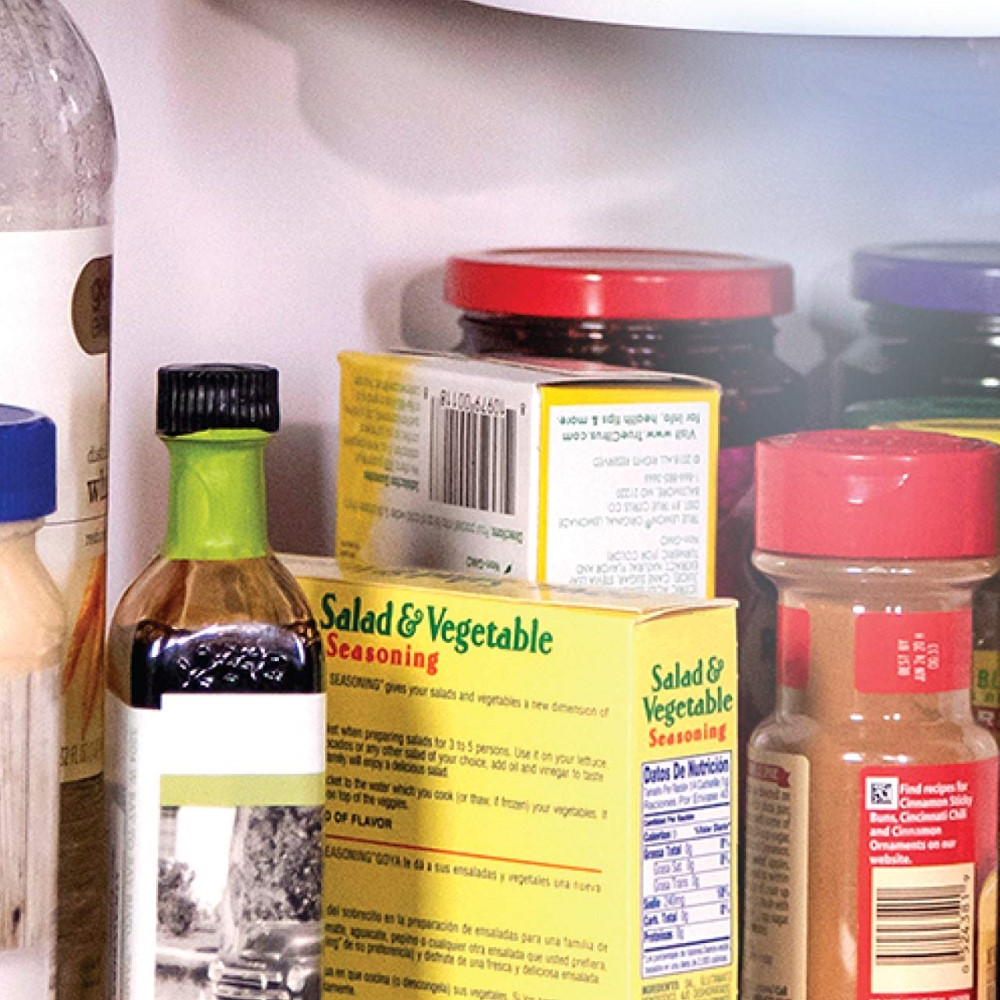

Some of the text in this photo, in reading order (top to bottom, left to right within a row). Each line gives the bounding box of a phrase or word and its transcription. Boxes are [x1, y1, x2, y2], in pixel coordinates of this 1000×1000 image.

[602, 412, 620, 426] tips
[623, 415, 657, 427] health
[675, 429, 696, 440] Visit
[320, 592, 554, 655] Salad & Vegetable
[326, 632, 439, 676] Seasoning
[652, 655, 725, 692] Salad &
[642, 685, 733, 728] Vegetable
[649, 722, 727, 748] Seasoning
[643, 765, 671, 784] Datos
[901, 780, 968, 795] Find recipes for
[901, 797, 948, 808] Cinnamon
[333, 811, 393, 830] OF FLAVOR
[901, 810, 948, 822] Cincinnati
[870, 825, 942, 837] and Cinnamon
[870, 840, 926, 851] Ornaments
[928, 840, 940, 850] on
[869, 853, 913, 865] website.
